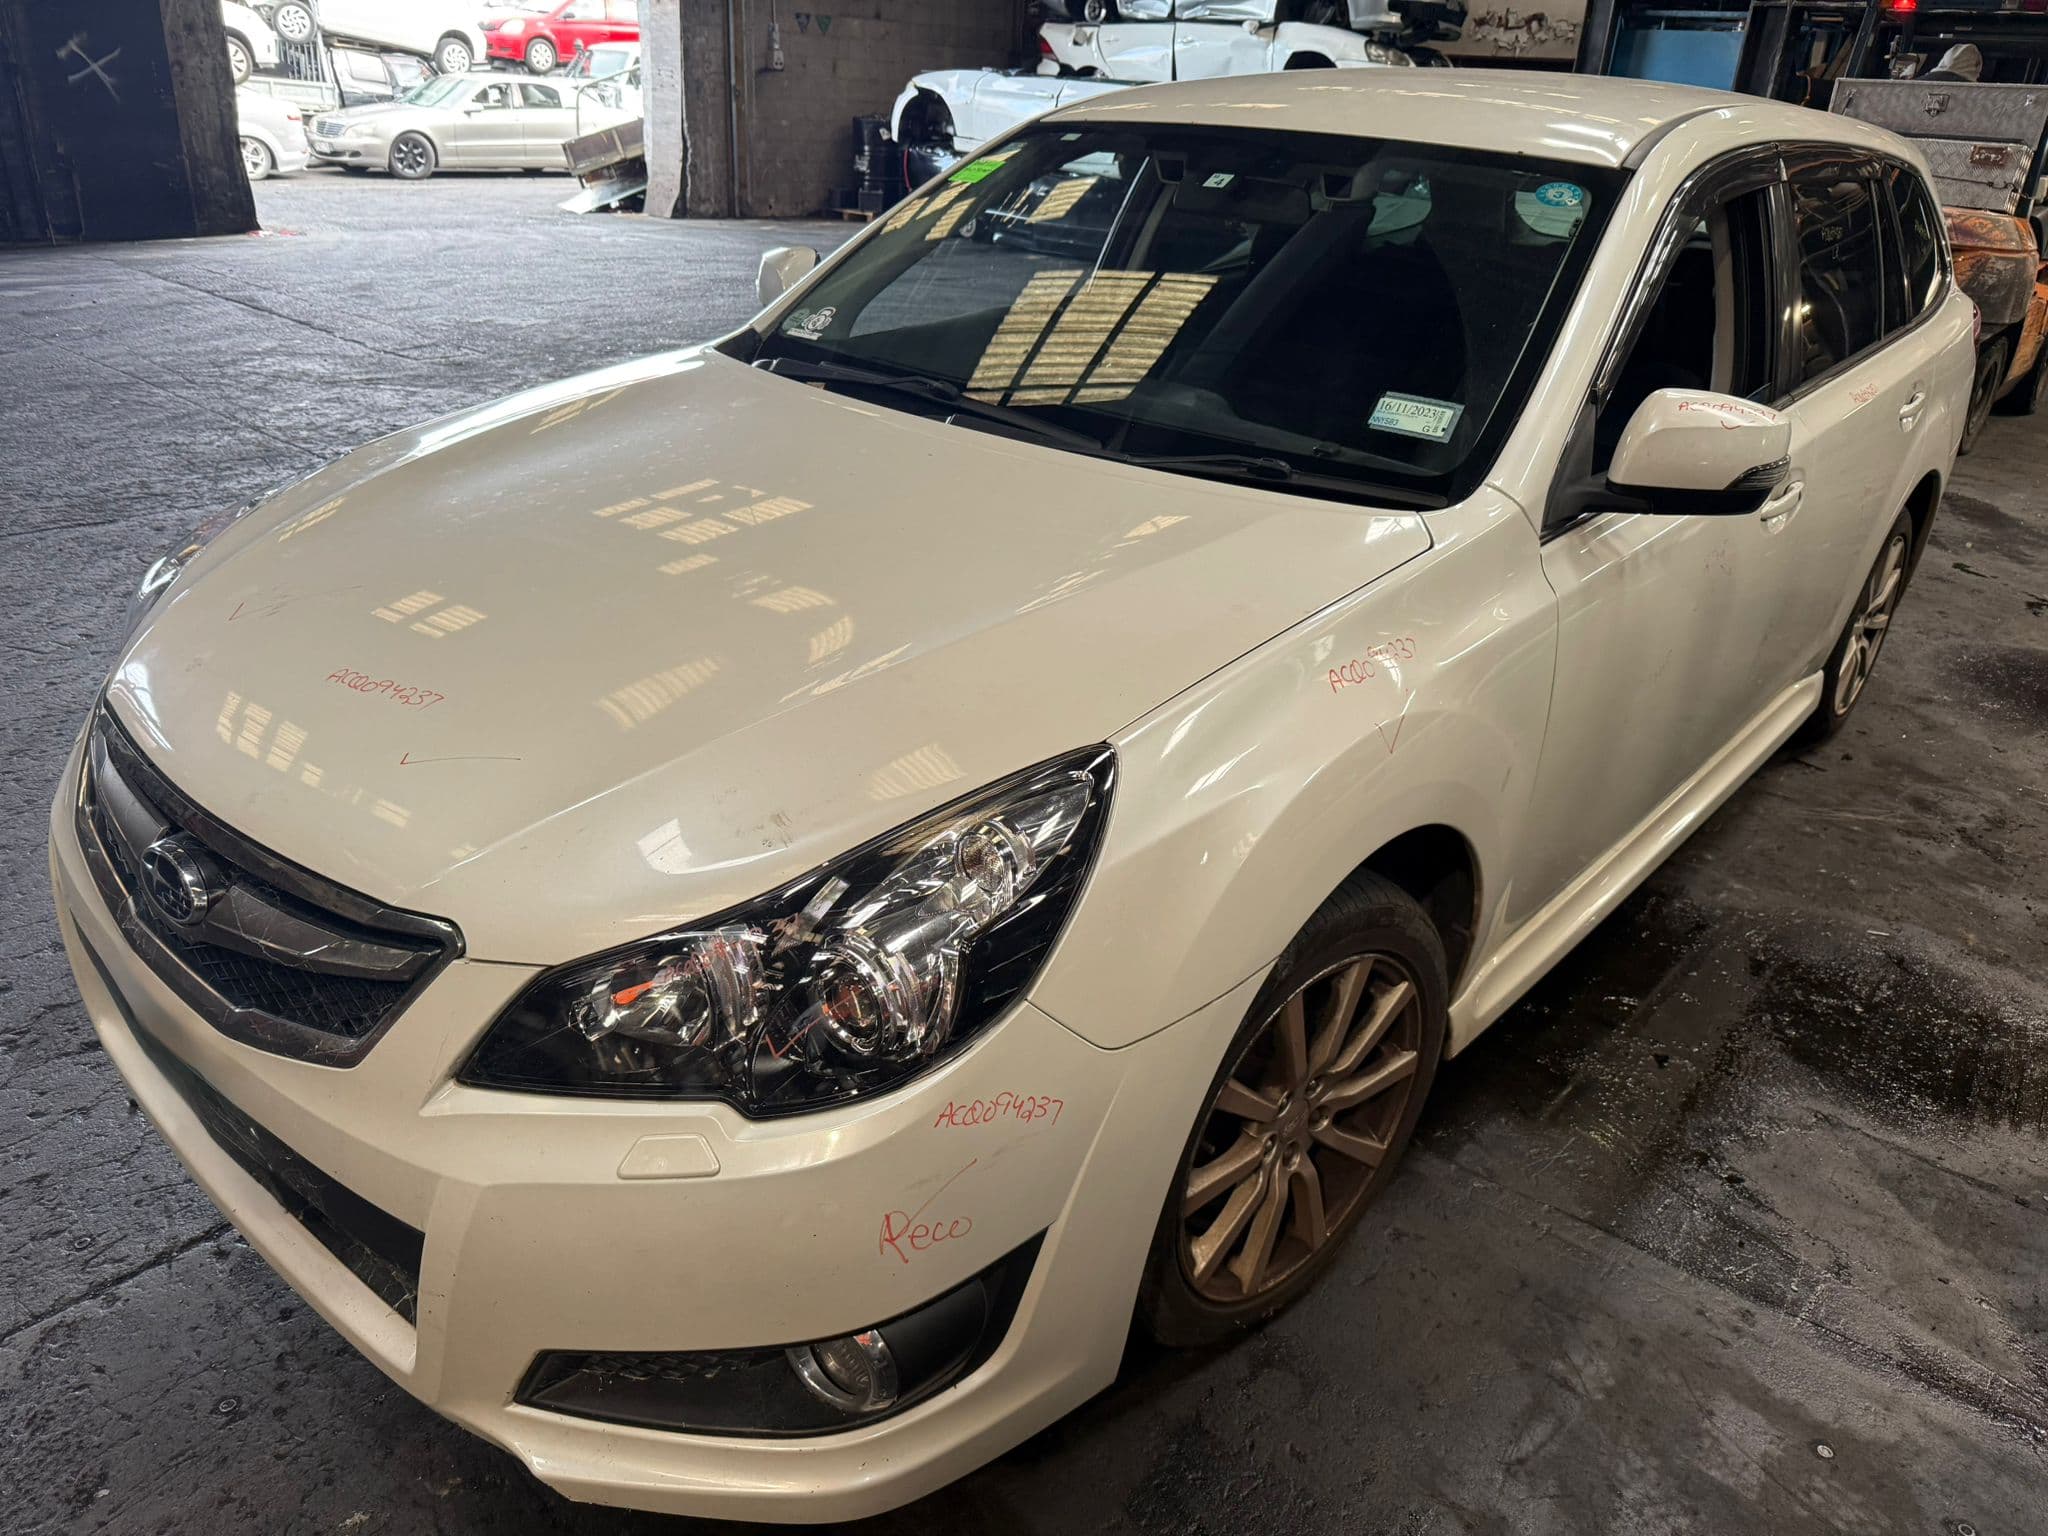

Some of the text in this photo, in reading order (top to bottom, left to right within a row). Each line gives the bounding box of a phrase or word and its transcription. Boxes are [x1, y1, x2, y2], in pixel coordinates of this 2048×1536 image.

[1379, 400, 1439, 419] 16/11/2023
[1422, 425, 1431, 433] G
[933, 1091, 1064, 1129] ACQ094237
[879, 1210, 973, 1264] Reco
